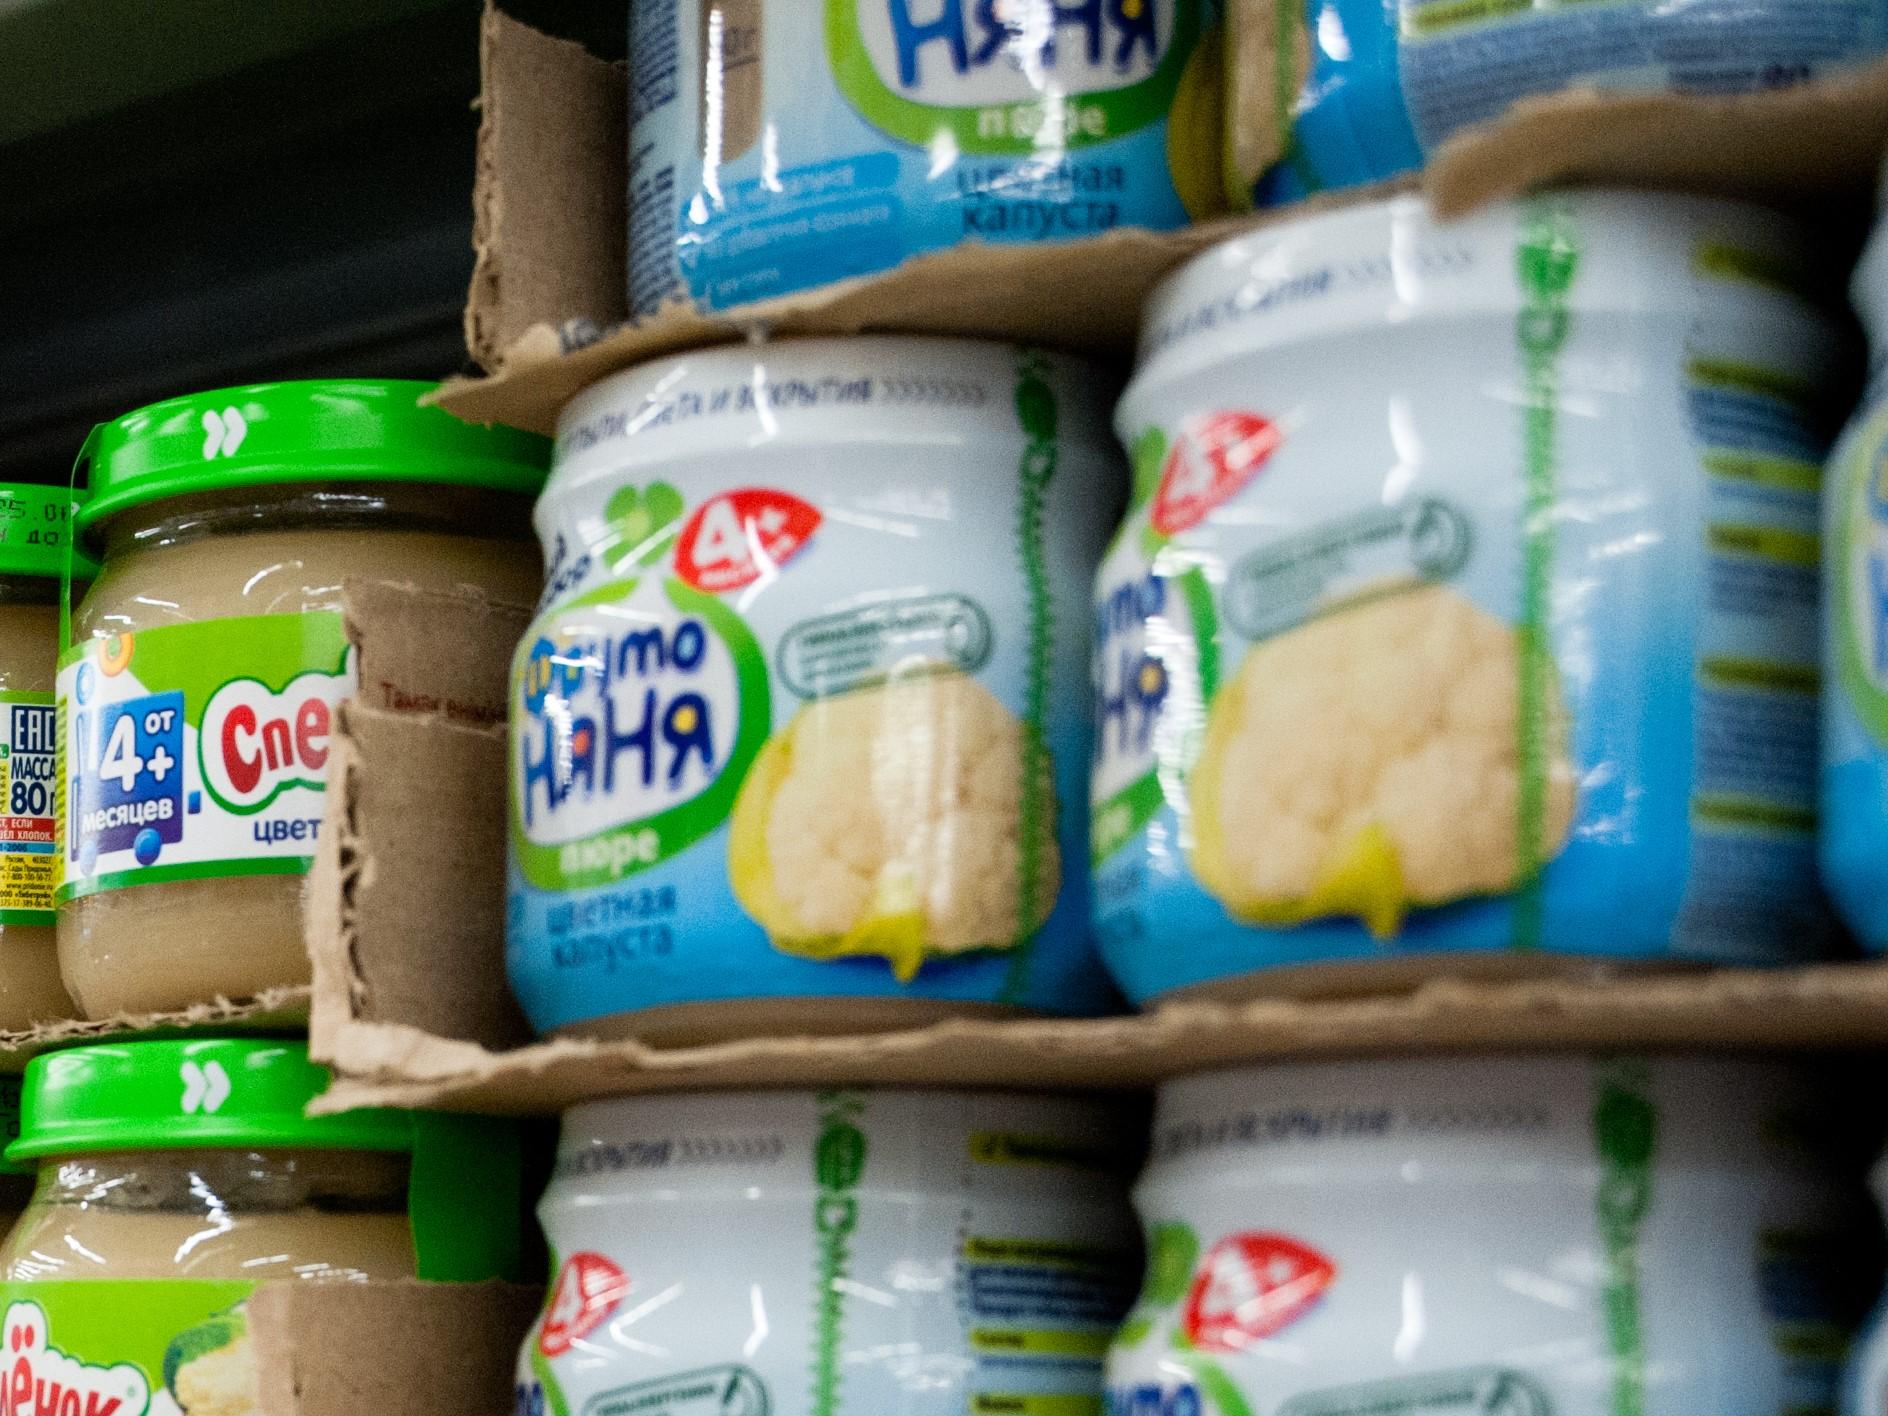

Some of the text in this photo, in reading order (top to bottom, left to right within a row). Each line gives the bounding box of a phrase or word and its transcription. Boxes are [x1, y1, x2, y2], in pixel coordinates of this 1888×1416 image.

[26, 530, 59, 545] до
[146, 710, 175, 734] от
[100, 714, 175, 792] 4+
[11, 782, 46, 815] 80
[12, 820, 32, 829] ЕСЛИ
[82, 798, 173, 834] месяцев
